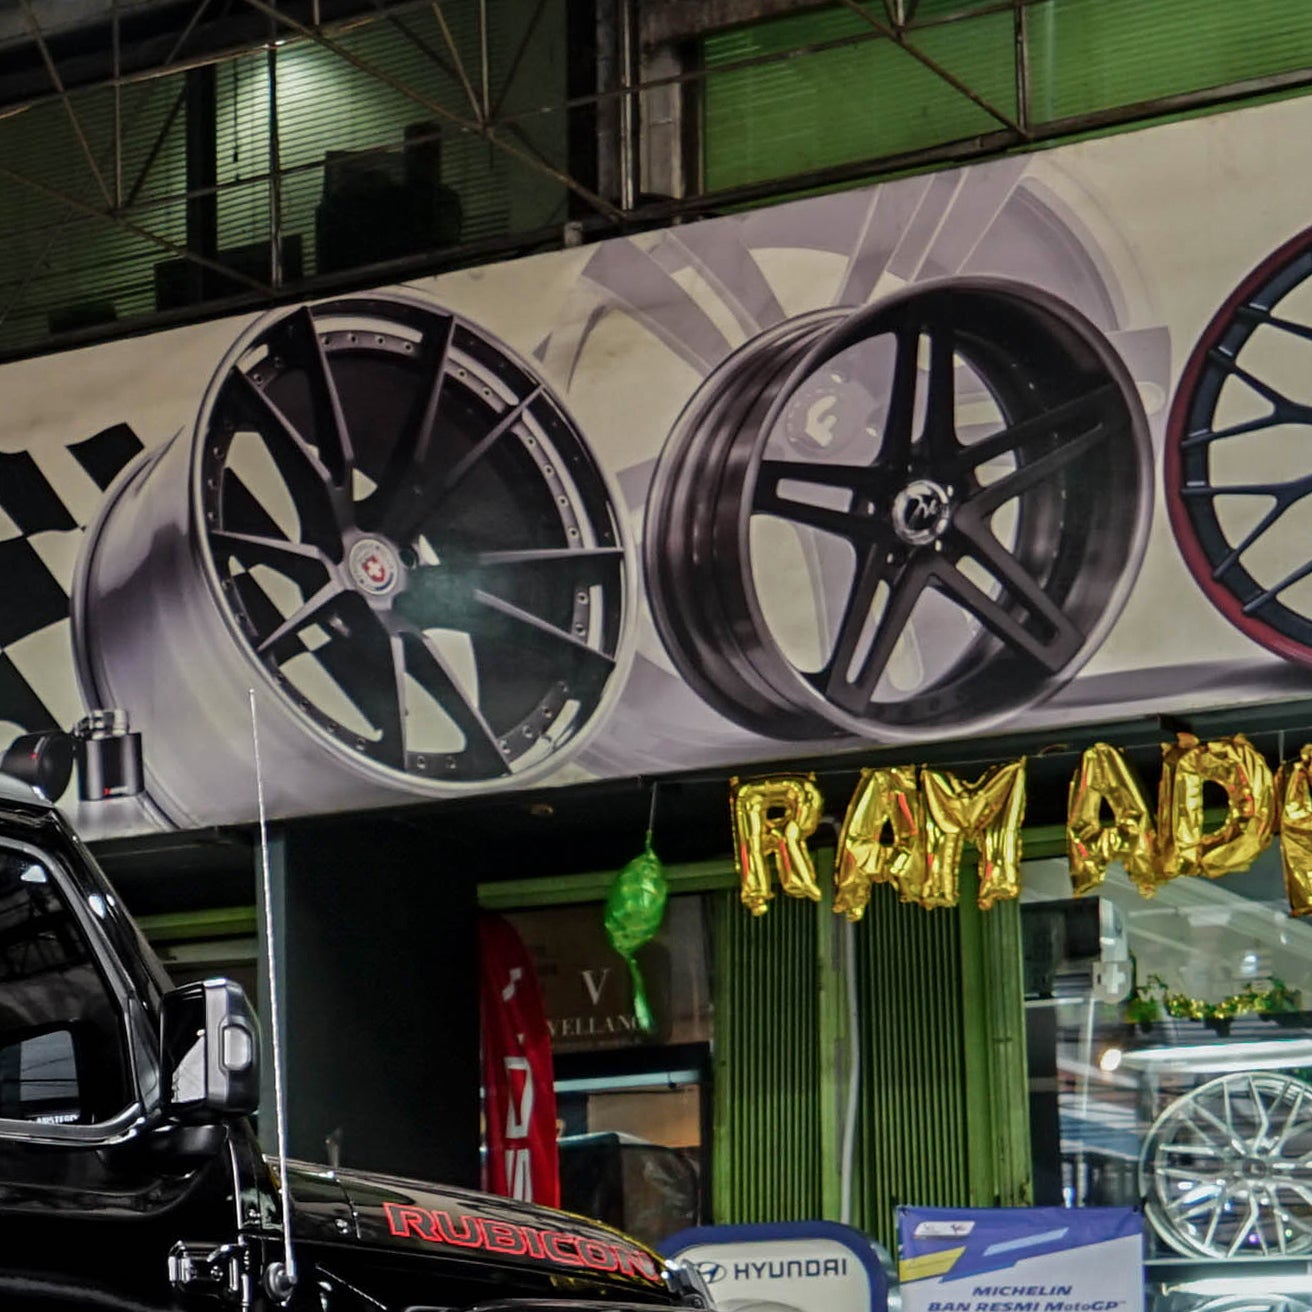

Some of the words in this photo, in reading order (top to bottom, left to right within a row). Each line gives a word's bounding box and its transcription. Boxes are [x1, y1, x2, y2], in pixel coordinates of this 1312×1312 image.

[382, 1202, 660, 1281] RUBICON
[734, 1258, 849, 1280] HYUNDAI
[972, 1285, 1073, 1297] MICHELIN
[928, 1301, 970, 1312] BAN
[974, 1301, 1039, 1312] RESMI
